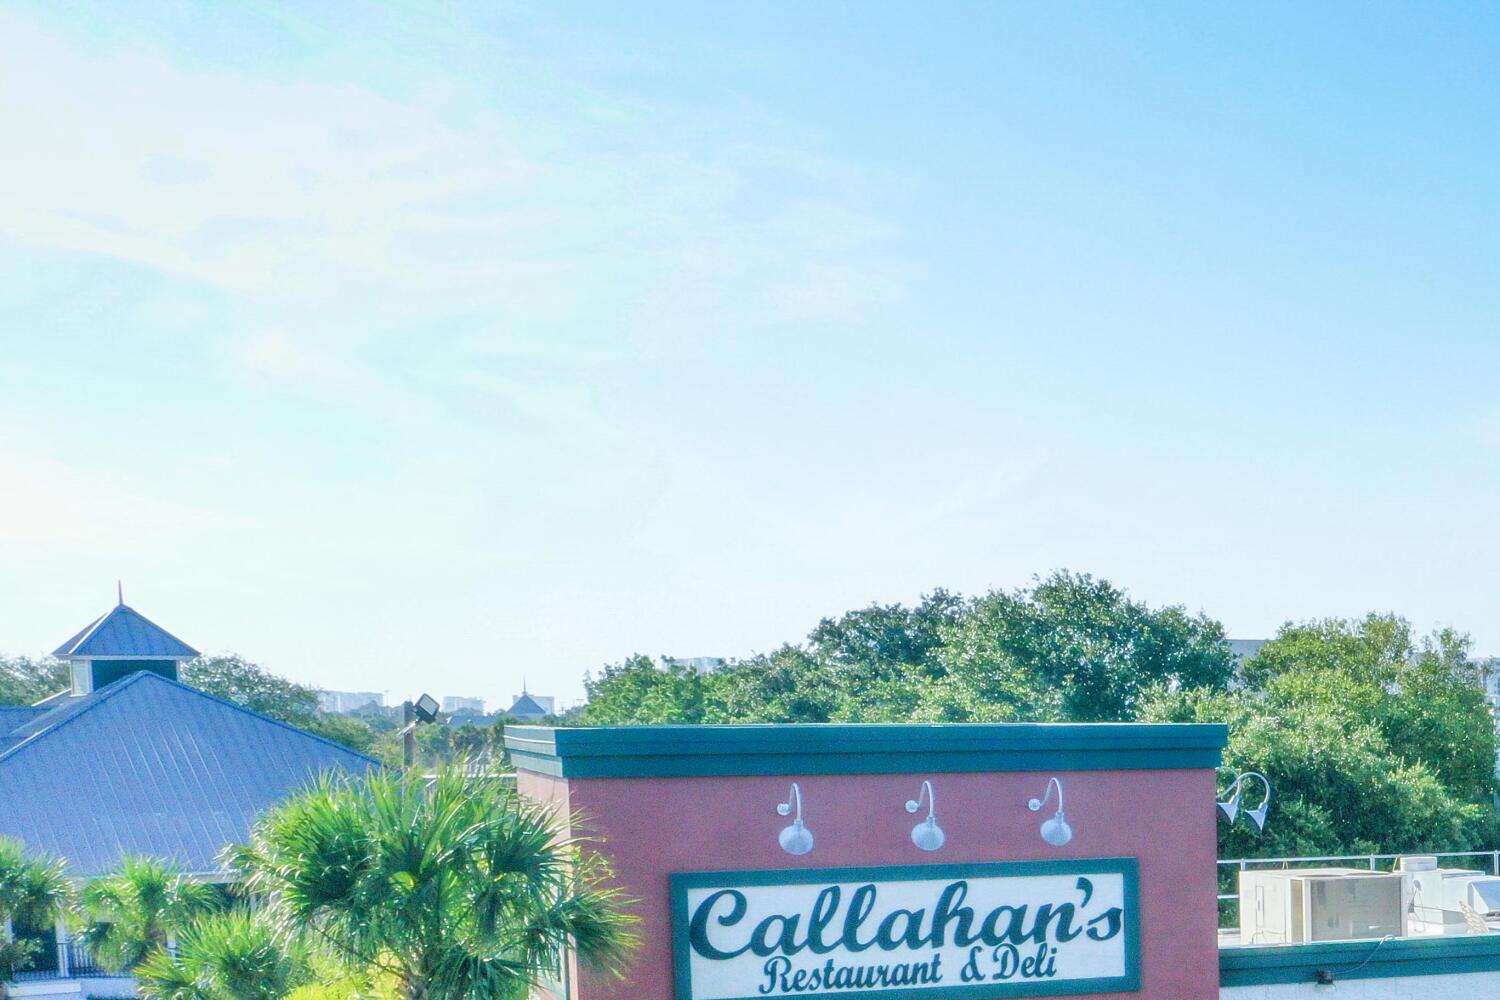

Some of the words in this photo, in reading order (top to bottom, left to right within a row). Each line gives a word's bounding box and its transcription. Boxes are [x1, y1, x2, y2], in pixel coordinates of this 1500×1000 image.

[689, 877, 1123, 960] Callahan's
[758, 953, 943, 994] Restaurant
[960, 949, 985, 983] &
[992, 942, 1057, 980] Deli
